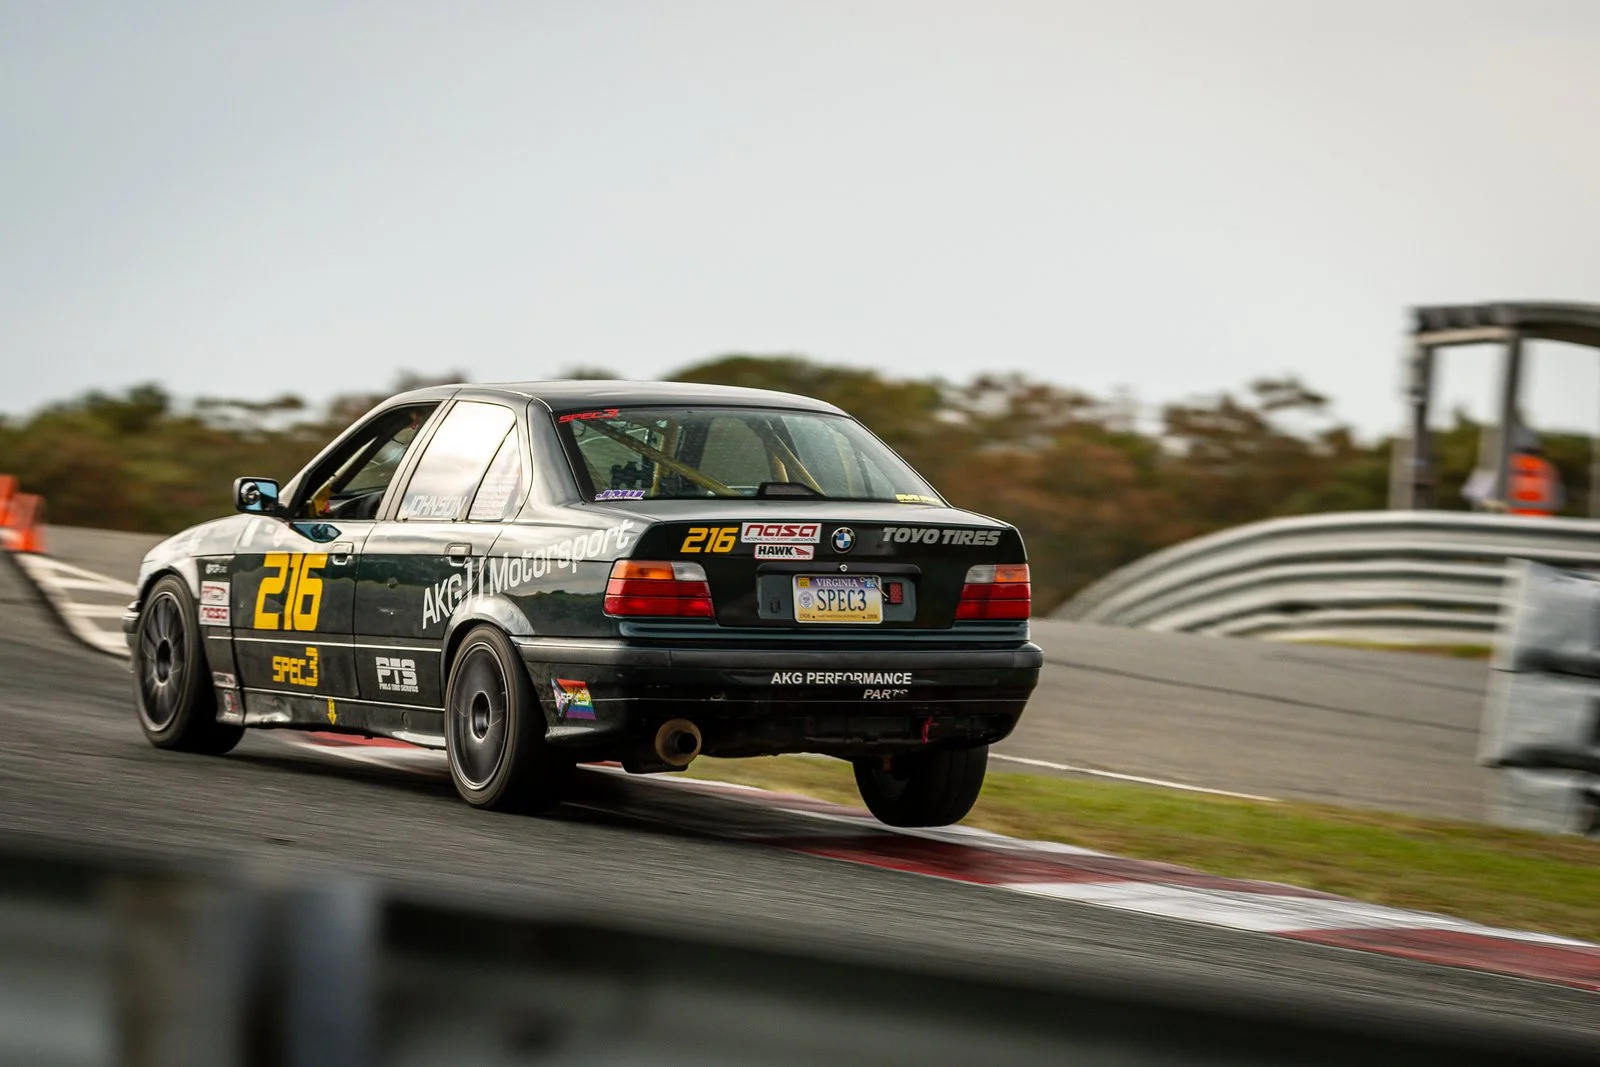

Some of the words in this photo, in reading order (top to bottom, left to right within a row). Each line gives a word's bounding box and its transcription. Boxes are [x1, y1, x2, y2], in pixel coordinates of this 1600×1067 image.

[403, 495, 468, 516] JOHNSON
[680, 527, 739, 553] 216
[882, 526, 940, 545] TOYO
[941, 529, 1002, 547] TIRES
[489, 519, 634, 597] Motorsport
[757, 545, 794, 556] HAWK
[253, 550, 329, 632] 216
[815, 578, 859, 588] VIRGINIA
[816, 588, 867, 613] SPEC3
[272, 646, 318, 688] SPEC3
[375, 656, 417, 686] PTS
[771, 672, 803, 685] AKG
[806, 672, 912, 685] PERFORMANCE
